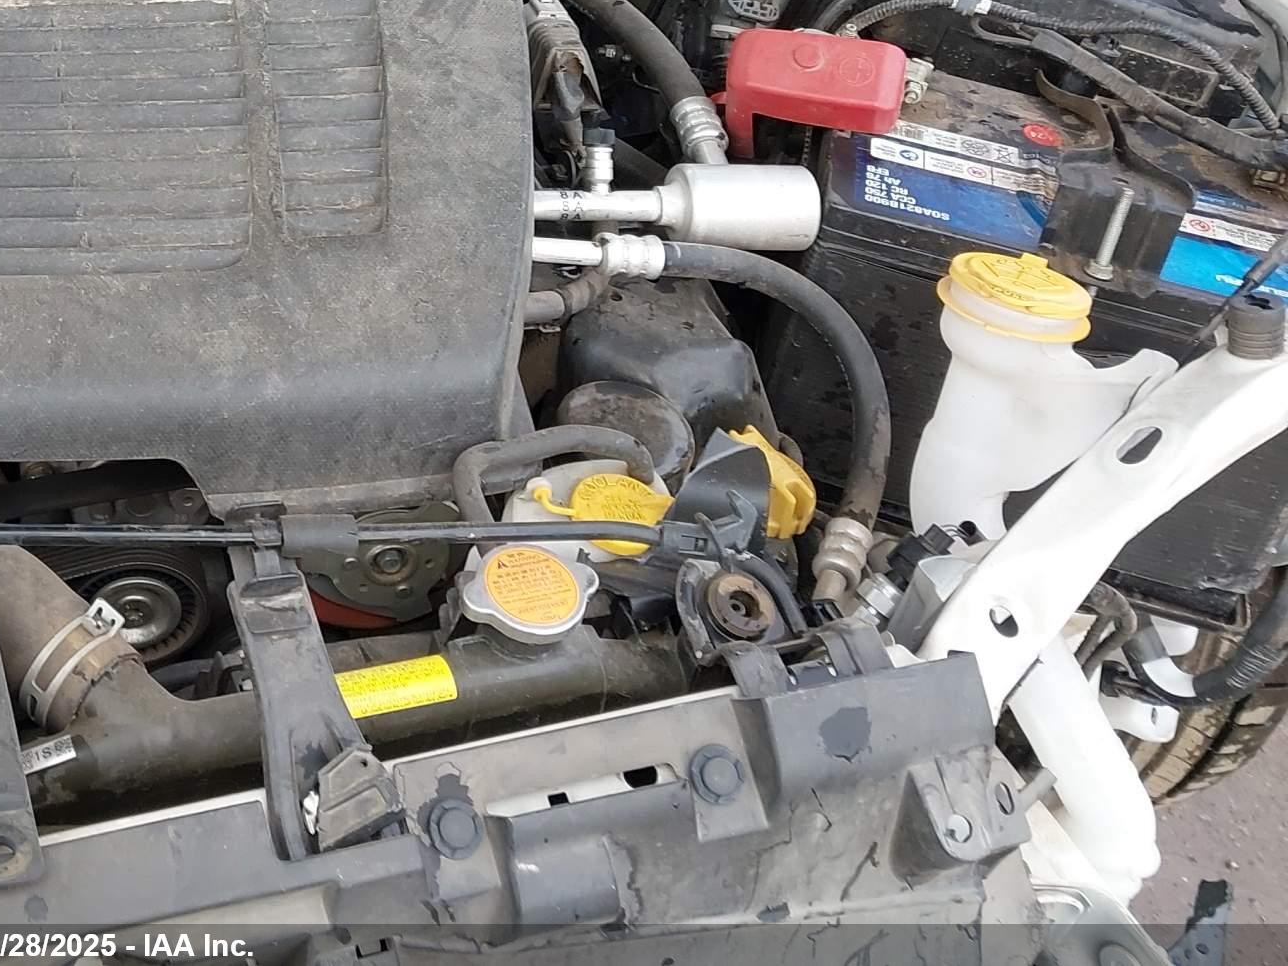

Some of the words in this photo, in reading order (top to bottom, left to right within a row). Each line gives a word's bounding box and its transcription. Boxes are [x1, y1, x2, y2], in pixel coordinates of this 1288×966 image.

[367, 118, 382, 135] B
[865, 179, 888, 190] 120
[891, 192, 917, 205] CCA
